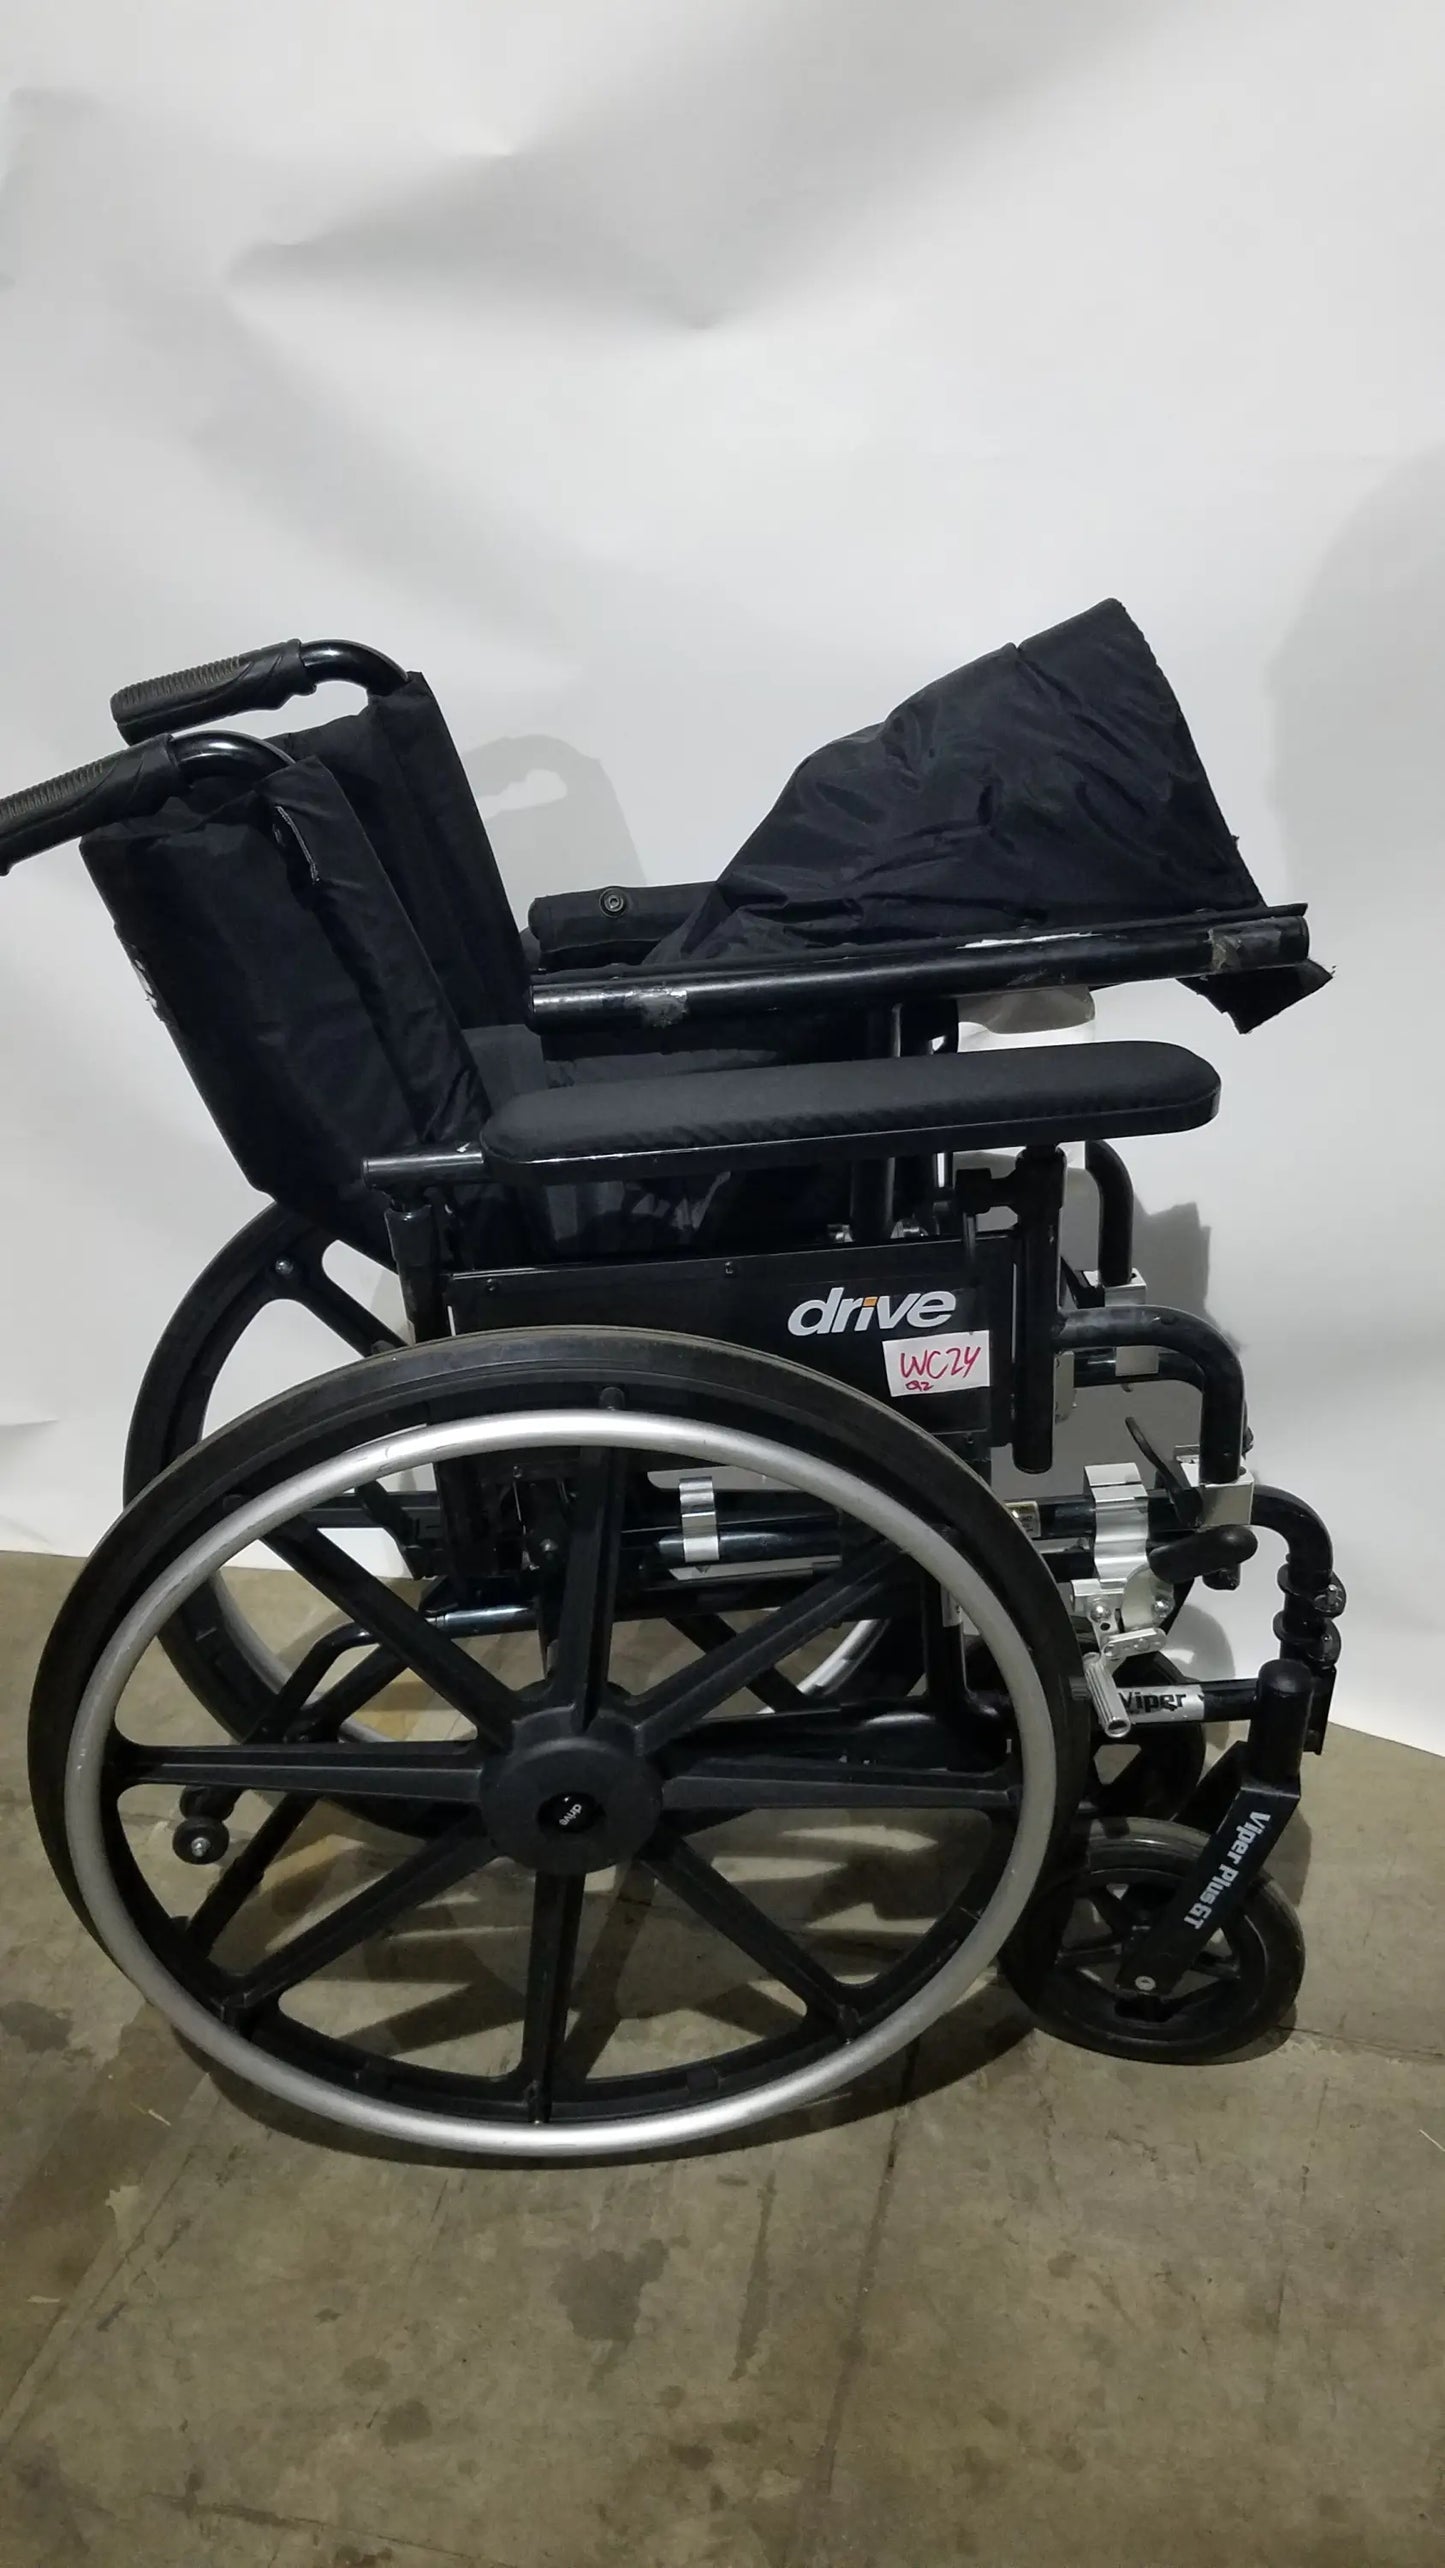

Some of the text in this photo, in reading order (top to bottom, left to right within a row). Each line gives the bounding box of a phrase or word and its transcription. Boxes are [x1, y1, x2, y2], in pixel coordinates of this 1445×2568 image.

[787, 1287, 957, 1336] drive
[1118, 1691, 1187, 1713] Viper
[1183, 1811, 1271, 1929] Viper Plus GT
